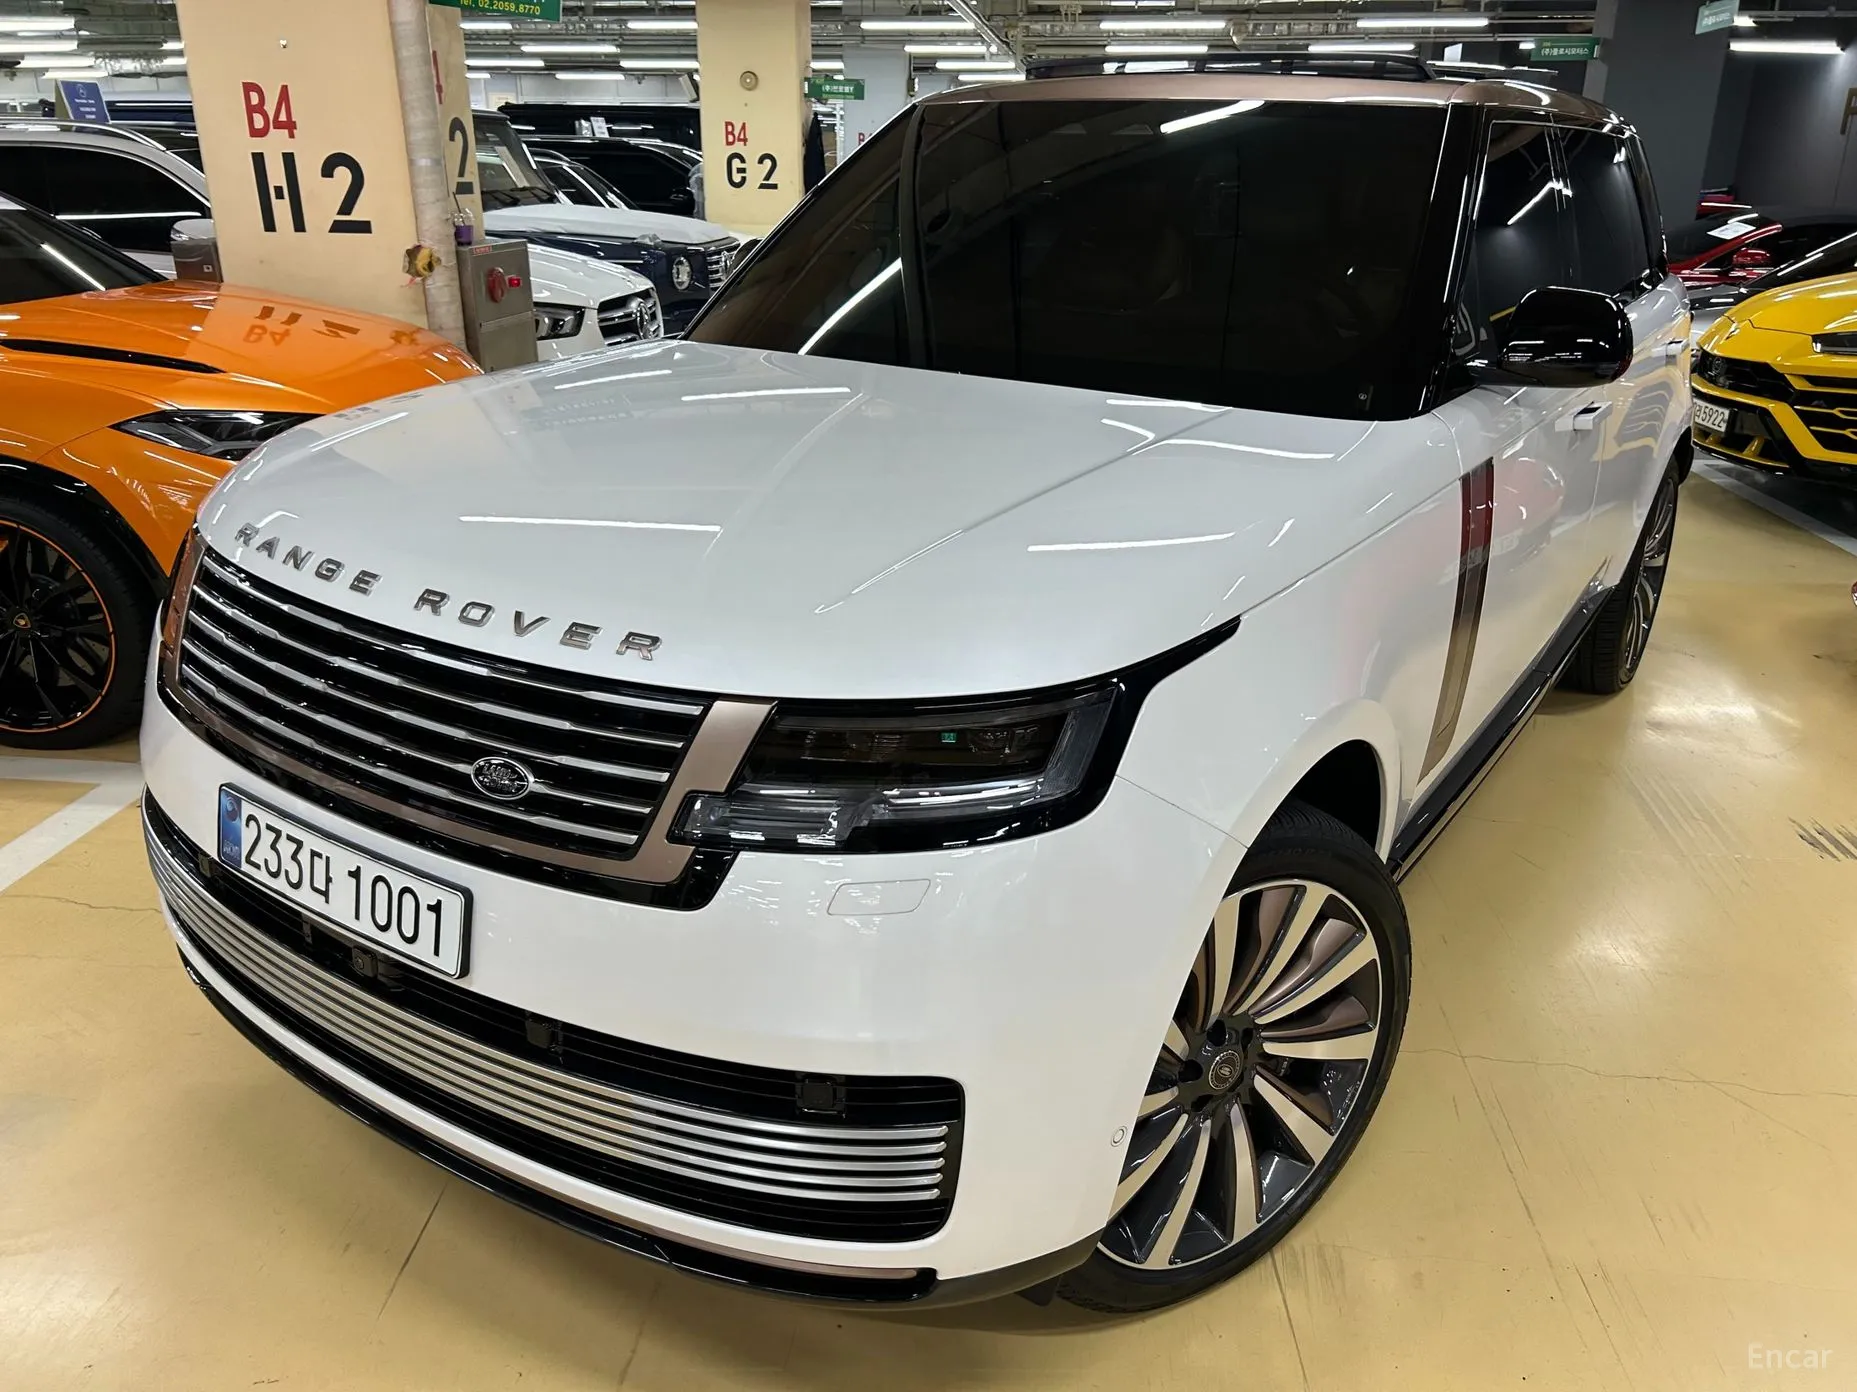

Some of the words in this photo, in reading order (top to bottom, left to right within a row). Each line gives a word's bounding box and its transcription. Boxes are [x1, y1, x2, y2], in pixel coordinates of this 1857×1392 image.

[242, 82, 297, 139] B4
[725, 121, 748, 146] B4
[448, 117, 474, 194] 2
[727, 152, 747, 188] G
[757, 153, 778, 189] 2
[251, 152, 306, 232] H
[321, 152, 372, 234] 2
[1701, 405, 1725, 428] 5922
[234, 522, 383, 597] RANGE
[414, 588, 663, 661] ROVER
[244, 813, 333, 904] 233다
[347, 865, 443, 957] 1001
